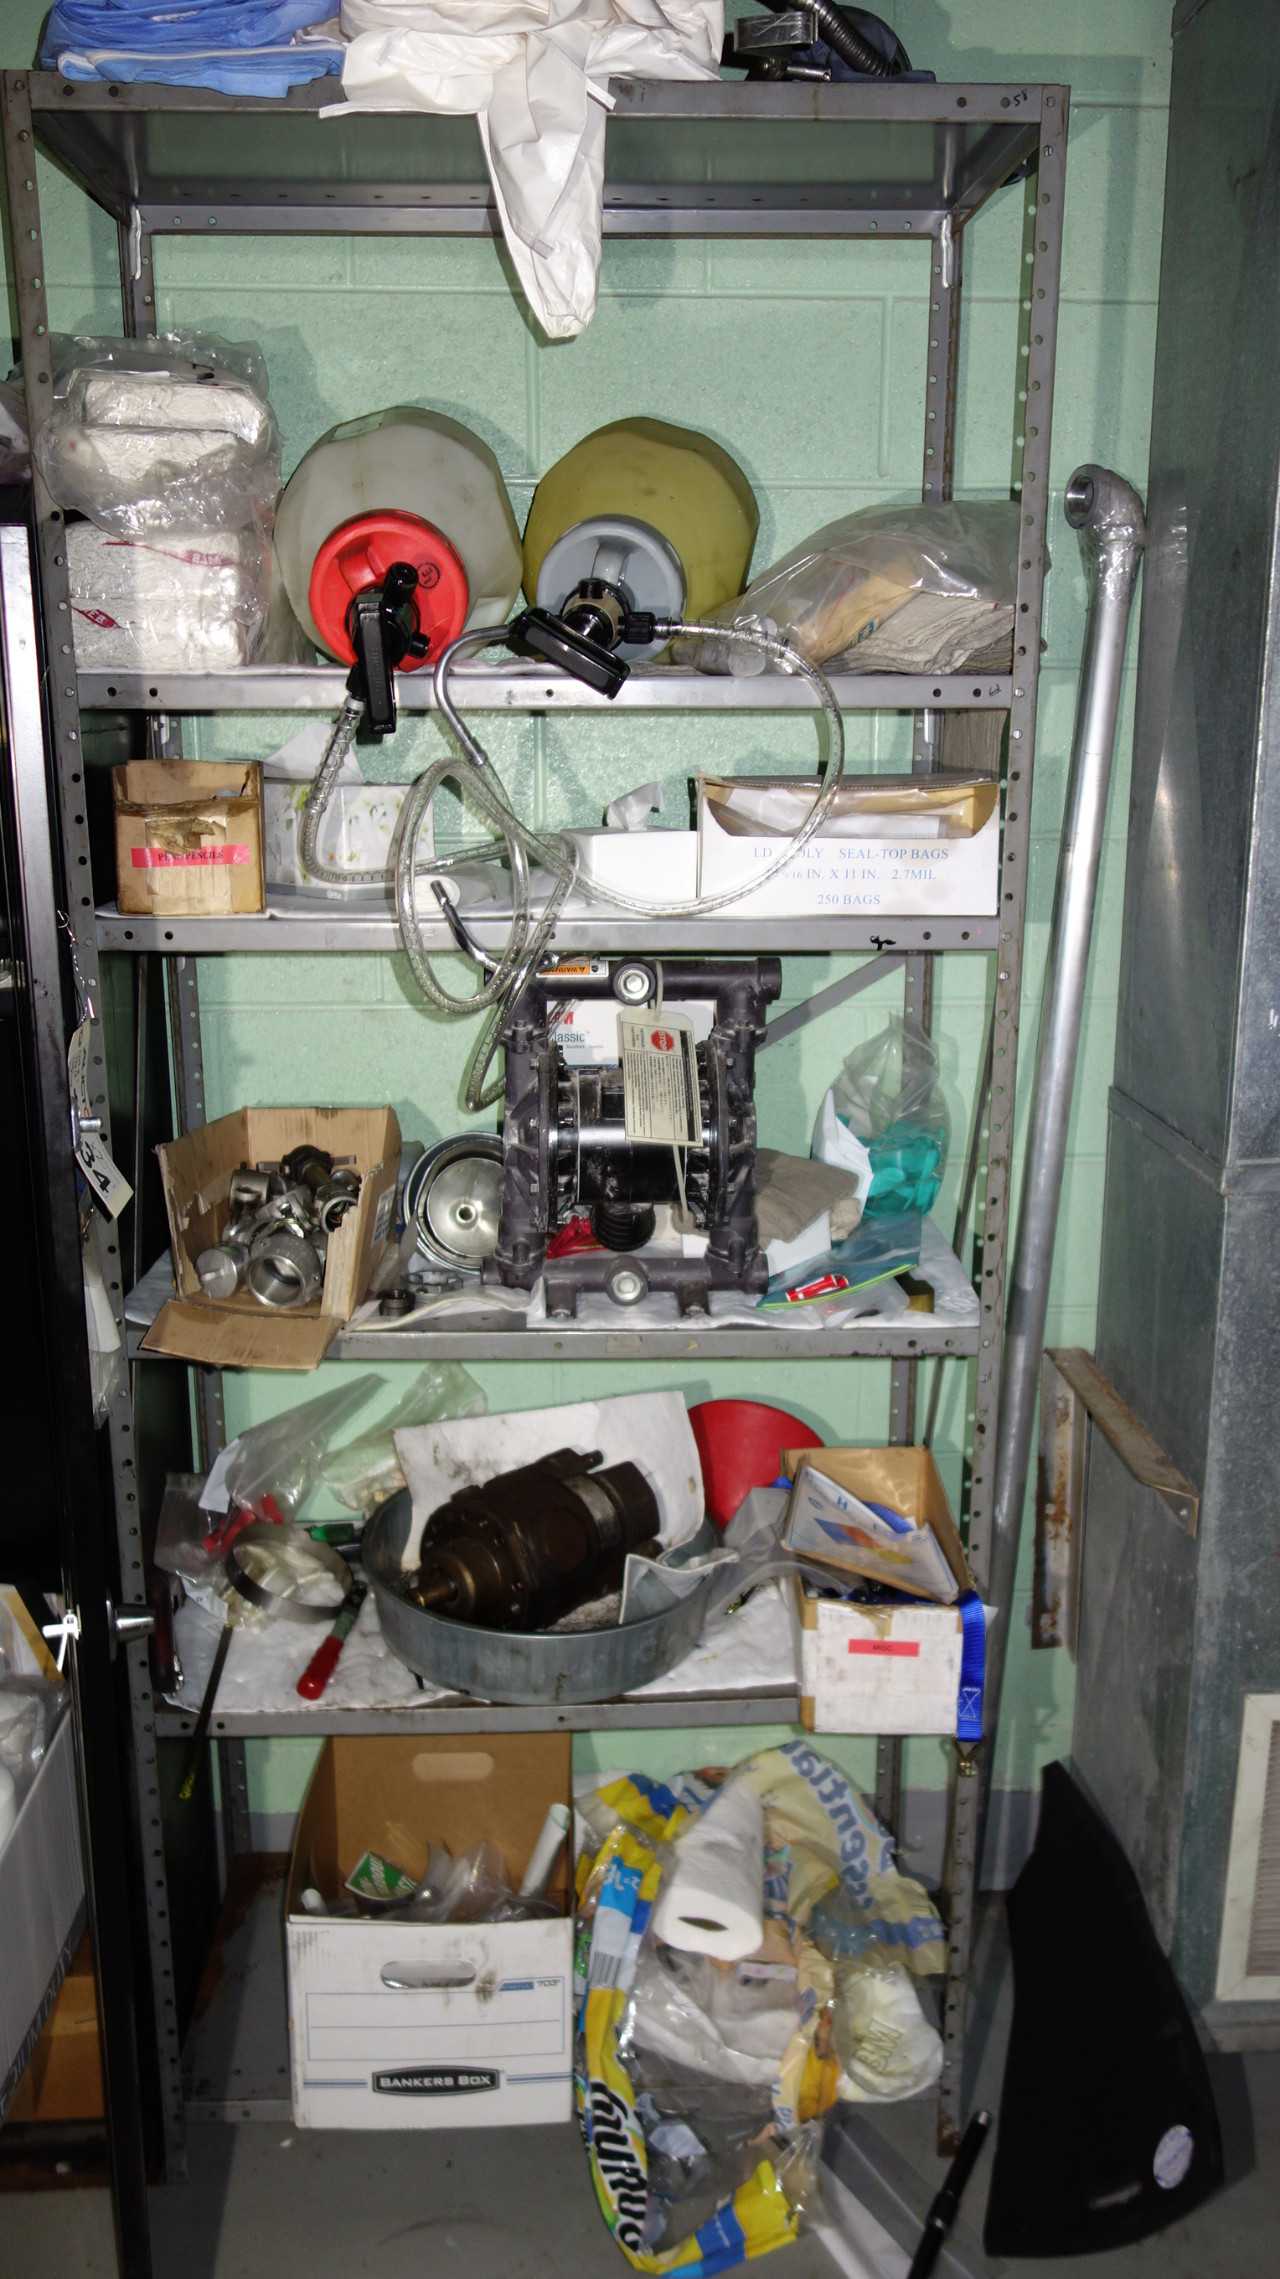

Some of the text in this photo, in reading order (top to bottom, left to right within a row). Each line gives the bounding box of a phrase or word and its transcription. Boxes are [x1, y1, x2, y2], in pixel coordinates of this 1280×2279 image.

[839, 848, 907, 860] SEAL-TOP
[911, 848, 949, 860] BAGS
[829, 868, 840, 880] X
[817, 893, 881, 905] 250 BAGS
[552, 1031, 585, 1042] lassic
[379, 2074, 491, 2088] BANKERS BOX
